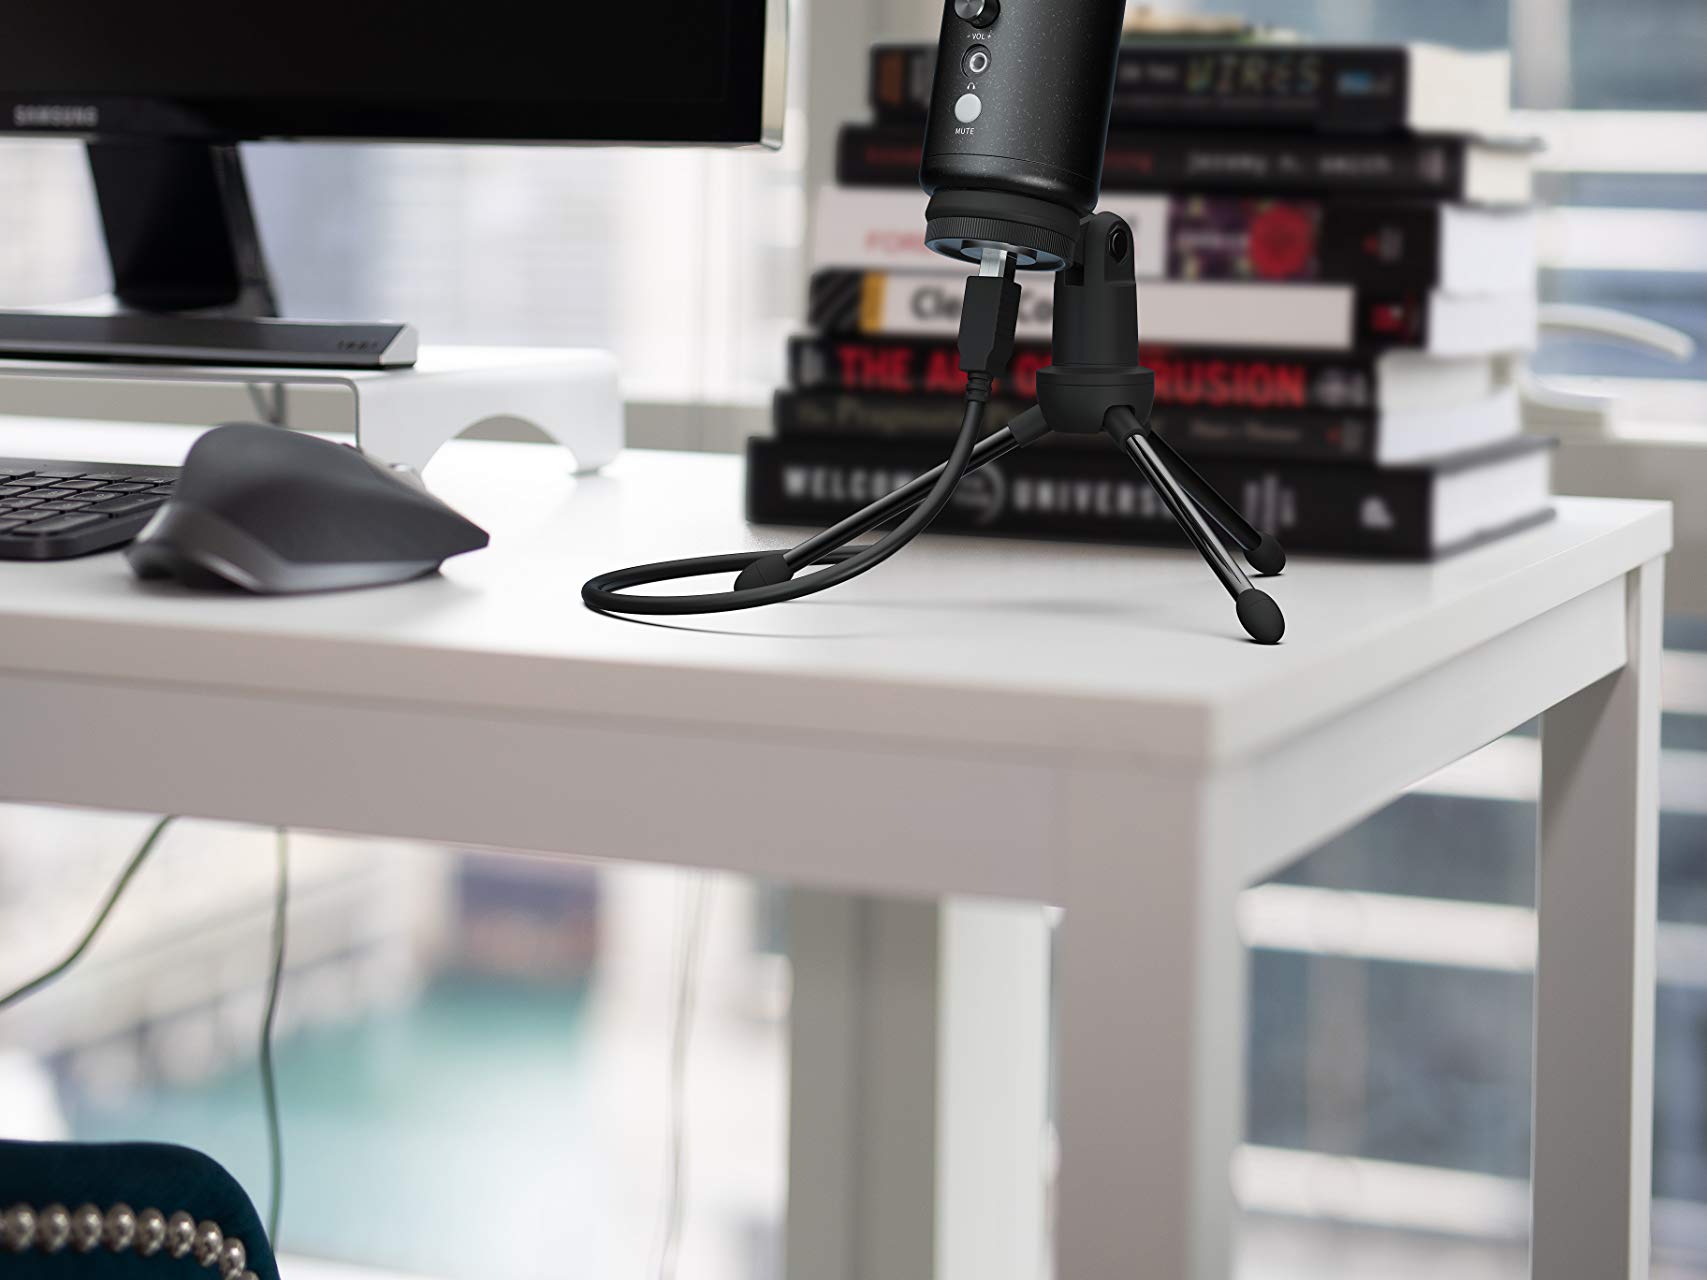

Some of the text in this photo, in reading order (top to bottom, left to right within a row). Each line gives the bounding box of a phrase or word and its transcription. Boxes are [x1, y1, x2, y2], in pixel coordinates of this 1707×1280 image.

[971, 32, 986, 40] VOL
[13, 104, 98, 127] SAMSUNG
[954, 127, 975, 135] MUTE
[910, 284, 963, 320] Cle
[838, 344, 912, 392] THE
[1138, 356, 1307, 408] RUSION
[782, 465, 911, 500] WELCO
[1013, 478, 1172, 520] UNIVERS
